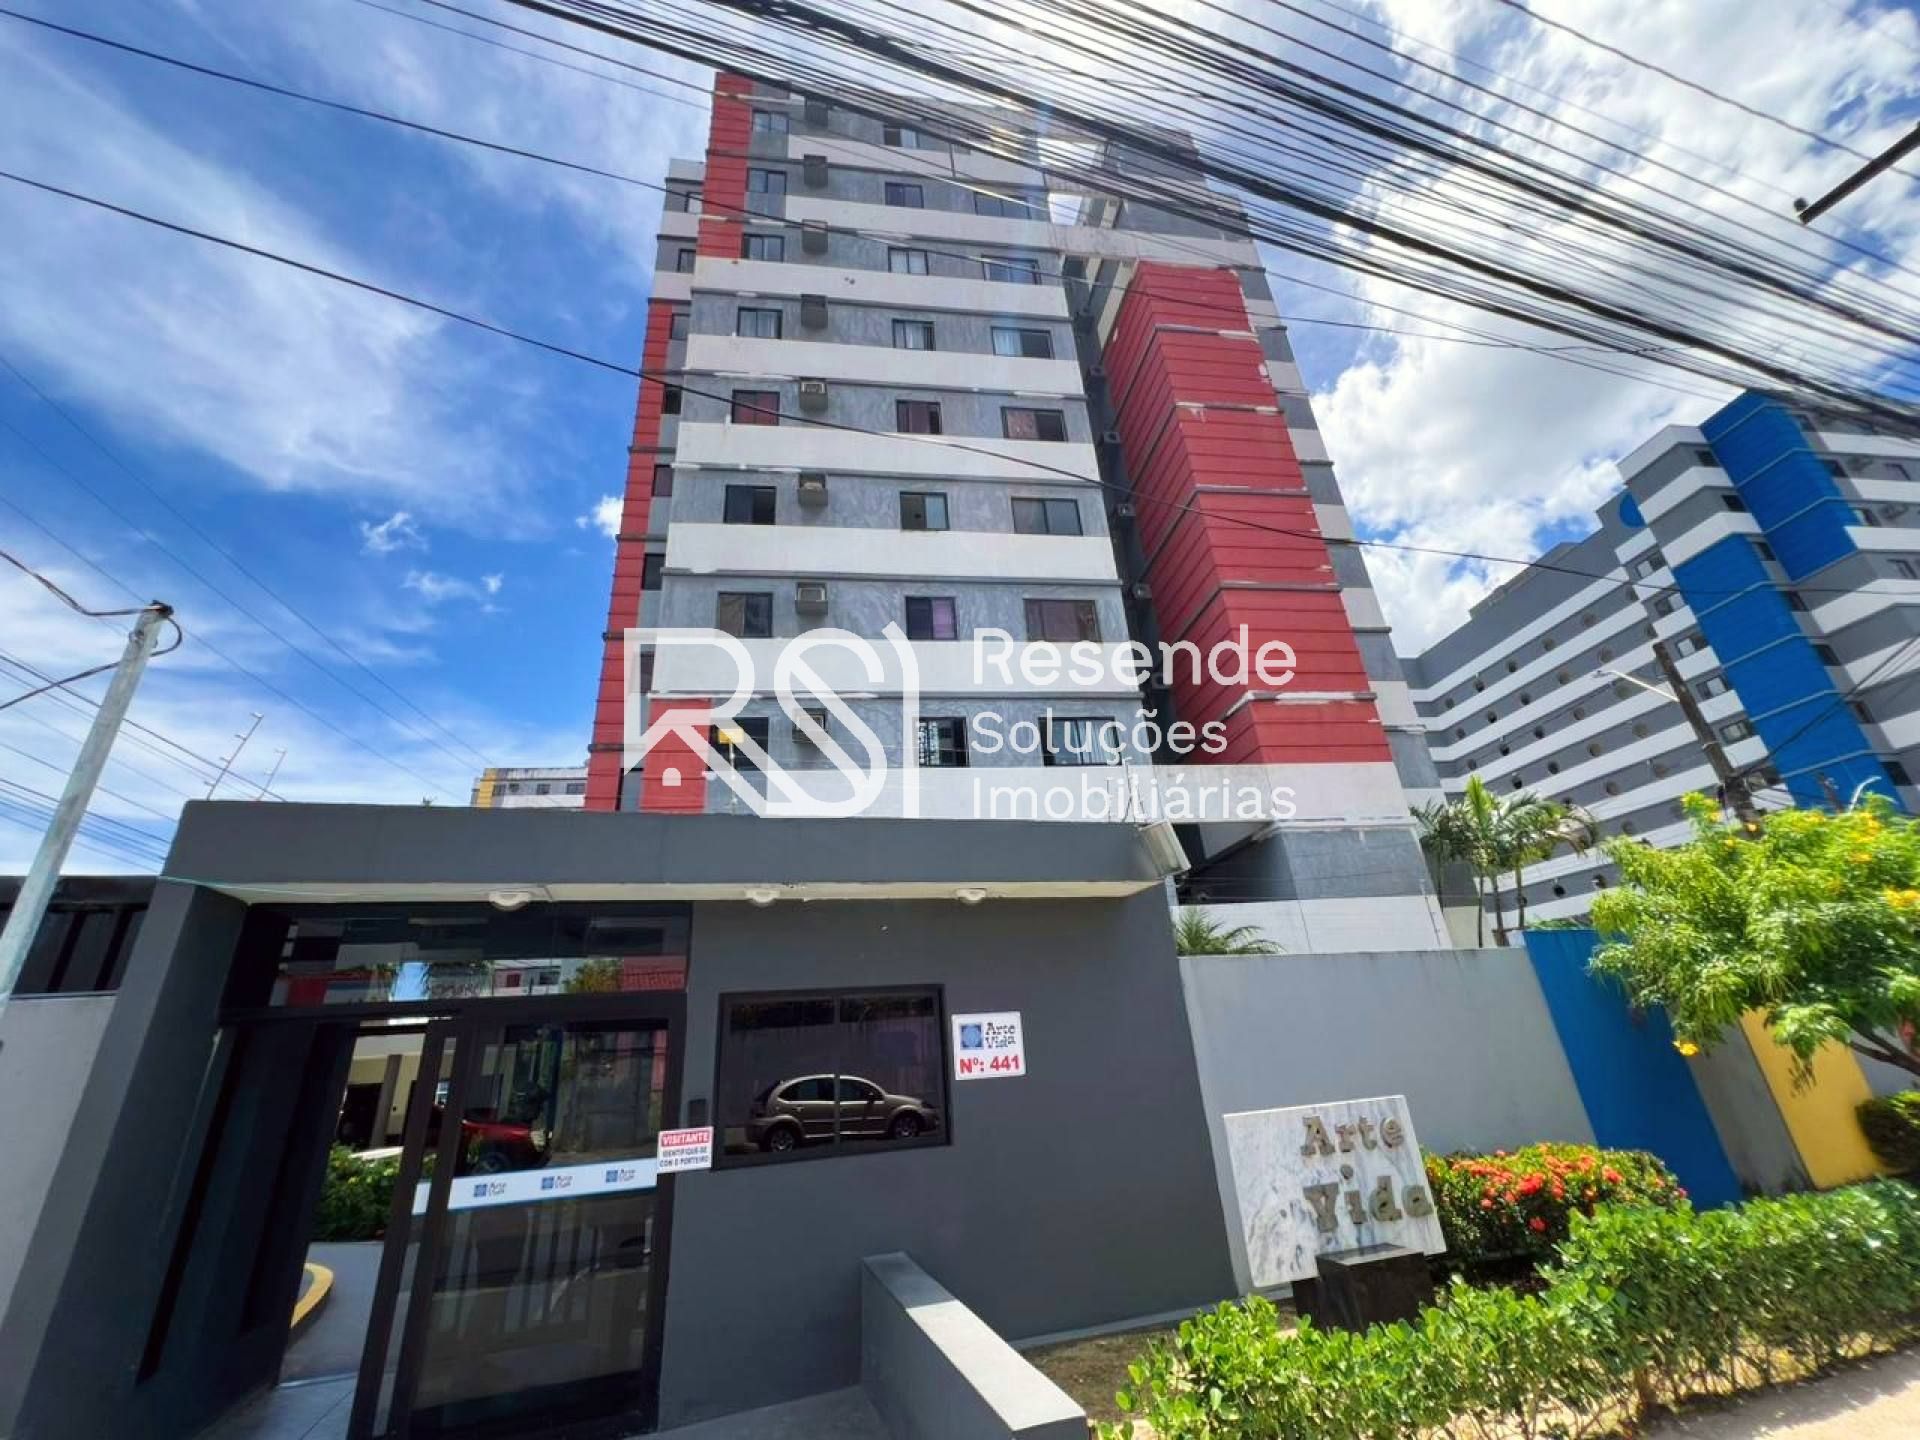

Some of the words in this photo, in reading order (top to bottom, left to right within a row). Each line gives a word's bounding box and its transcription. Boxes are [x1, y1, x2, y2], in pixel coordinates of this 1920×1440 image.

[985, 1022, 1016, 1036] Arte
[990, 1054, 1020, 1072] 441
[662, 1132, 709, 1146] VISITANTE
[1300, 1115, 1405, 1156] Arte
